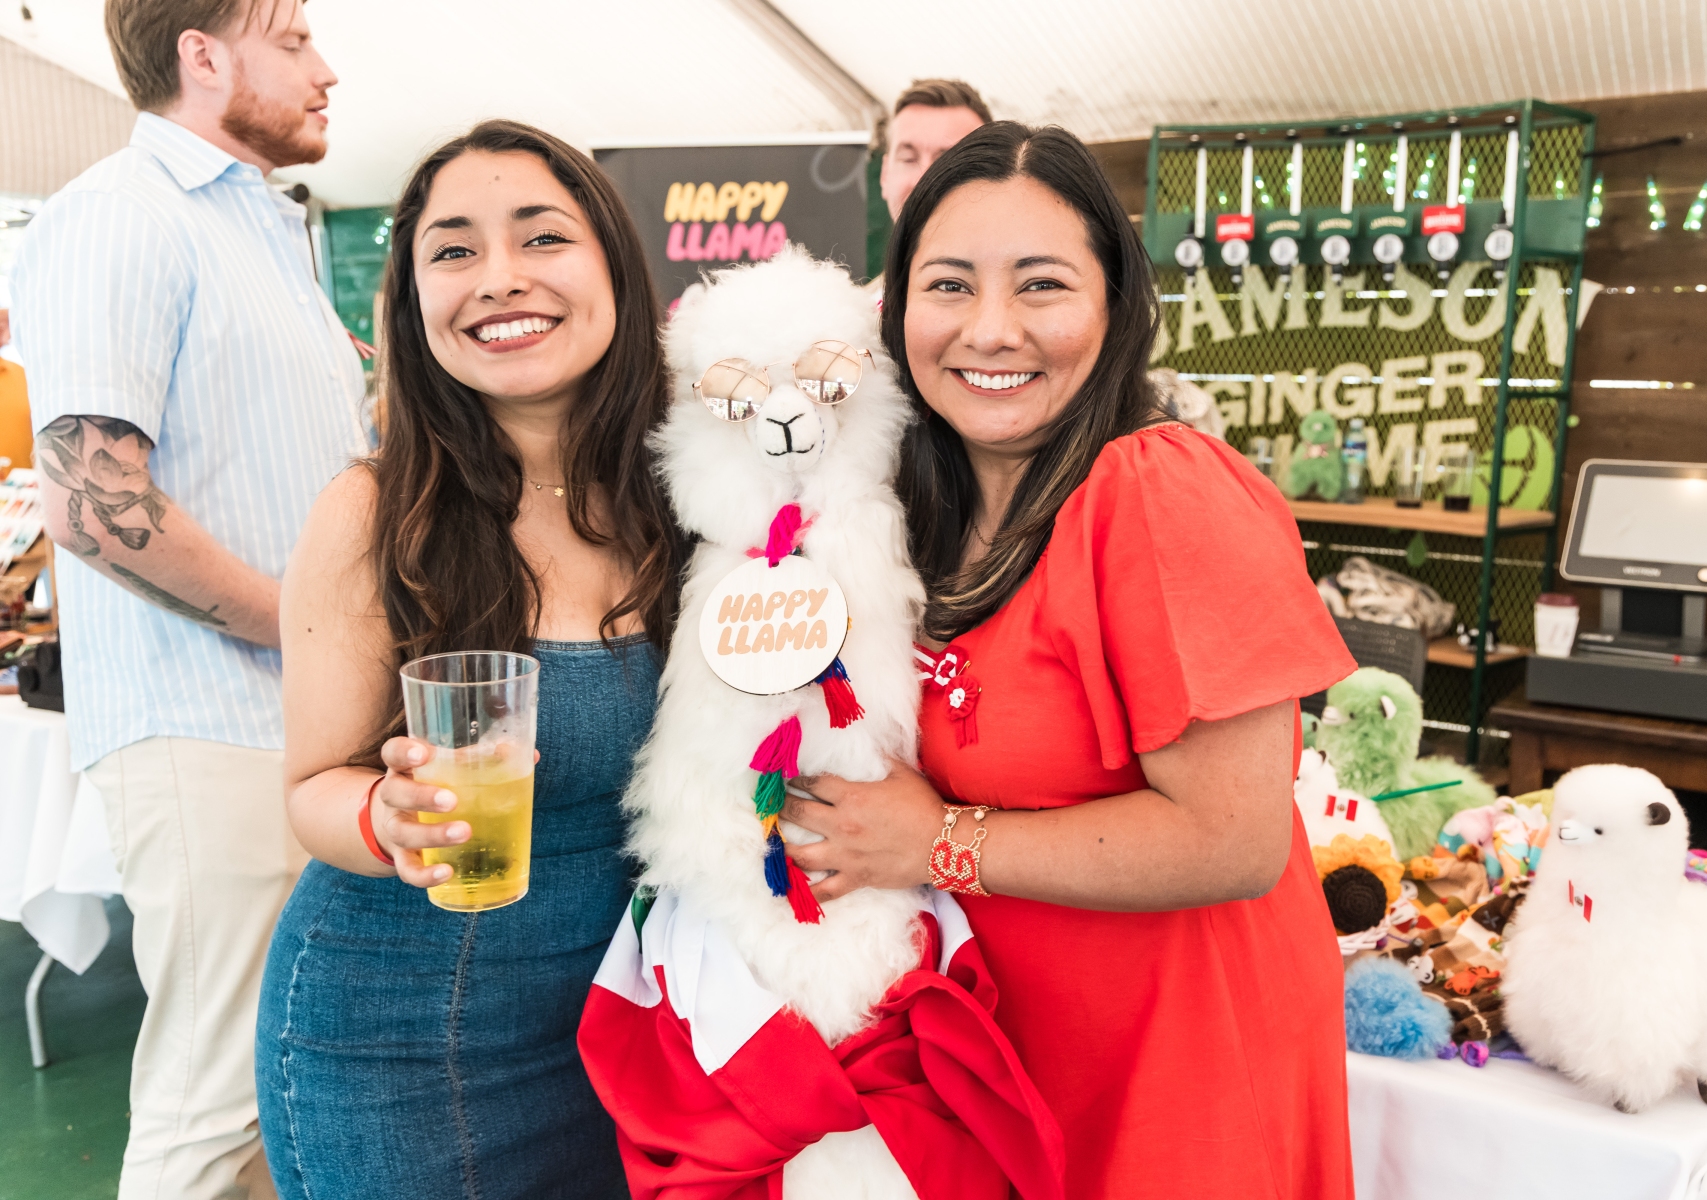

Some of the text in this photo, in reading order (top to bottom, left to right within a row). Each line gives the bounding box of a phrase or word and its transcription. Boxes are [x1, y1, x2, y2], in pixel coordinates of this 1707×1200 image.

[663, 181, 789, 223] HAPPY
[666, 221, 788, 262] LLAMA
[1148, 261, 1604, 368] AMESON
[1203, 350, 1485, 428] GINGER
[717, 588, 829, 624] HAPPY
[717, 619, 828, 656] LLAMA
